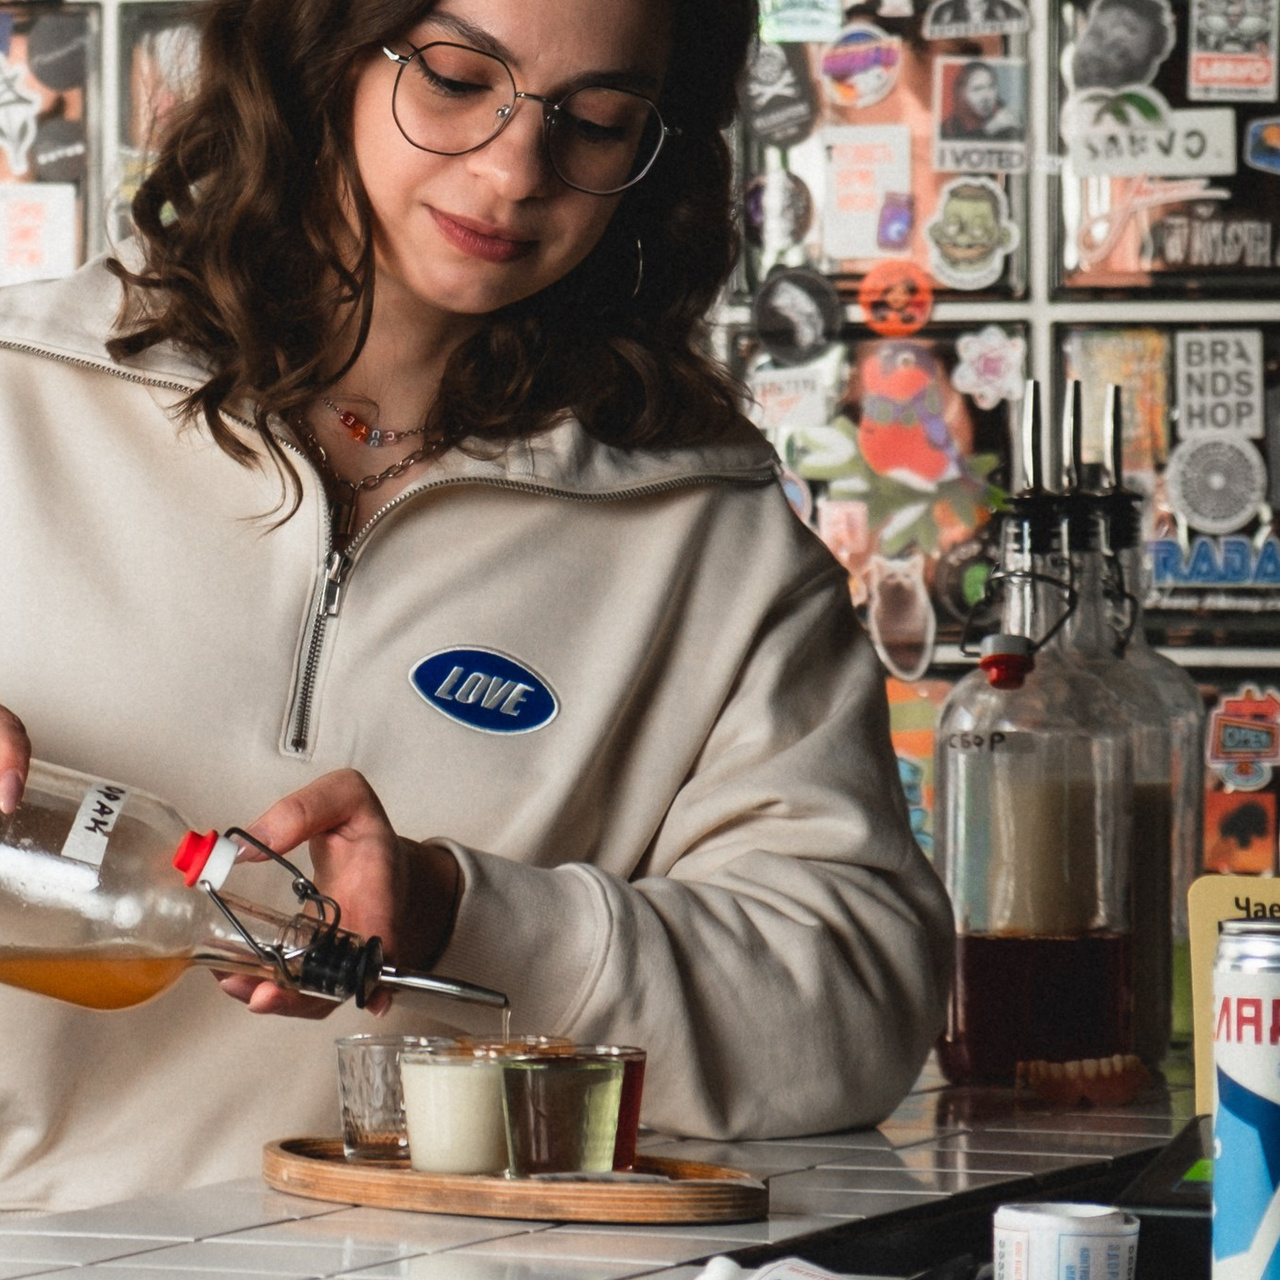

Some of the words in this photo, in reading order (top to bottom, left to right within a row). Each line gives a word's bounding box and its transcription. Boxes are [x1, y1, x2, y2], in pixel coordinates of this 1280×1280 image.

[953, 145, 1022, 167] VOTED
[1184, 340, 1252, 368] BRA
[1185, 369, 1254, 399] NDS
[1186, 401, 1254, 430] HOP
[434, 666, 535, 716] LOVE
